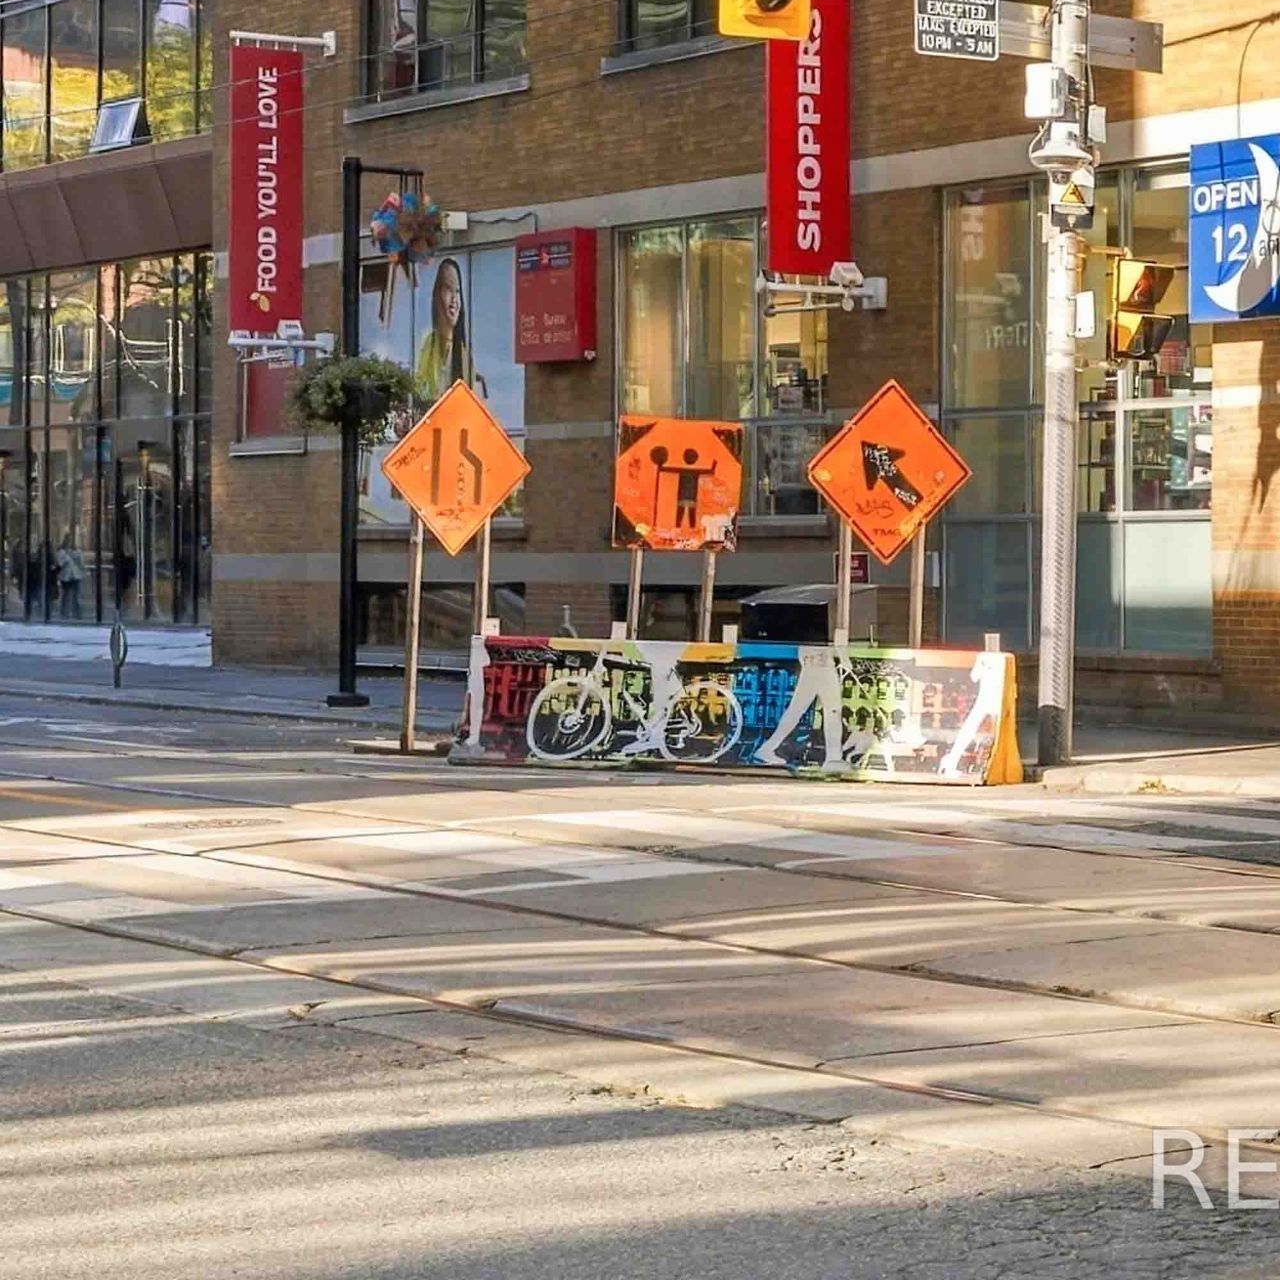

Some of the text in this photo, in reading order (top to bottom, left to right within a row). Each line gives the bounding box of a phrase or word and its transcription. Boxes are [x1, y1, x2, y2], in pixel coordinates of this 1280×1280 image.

[927, 1, 987, 19] EXCEPTED
[950, 20, 997, 38] EXCEPTED
[257, 66, 278, 292] FOOD YOU'LL LOVE
[1193, 179, 1258, 214] OPEN
[1211, 223, 1249, 264] 12
